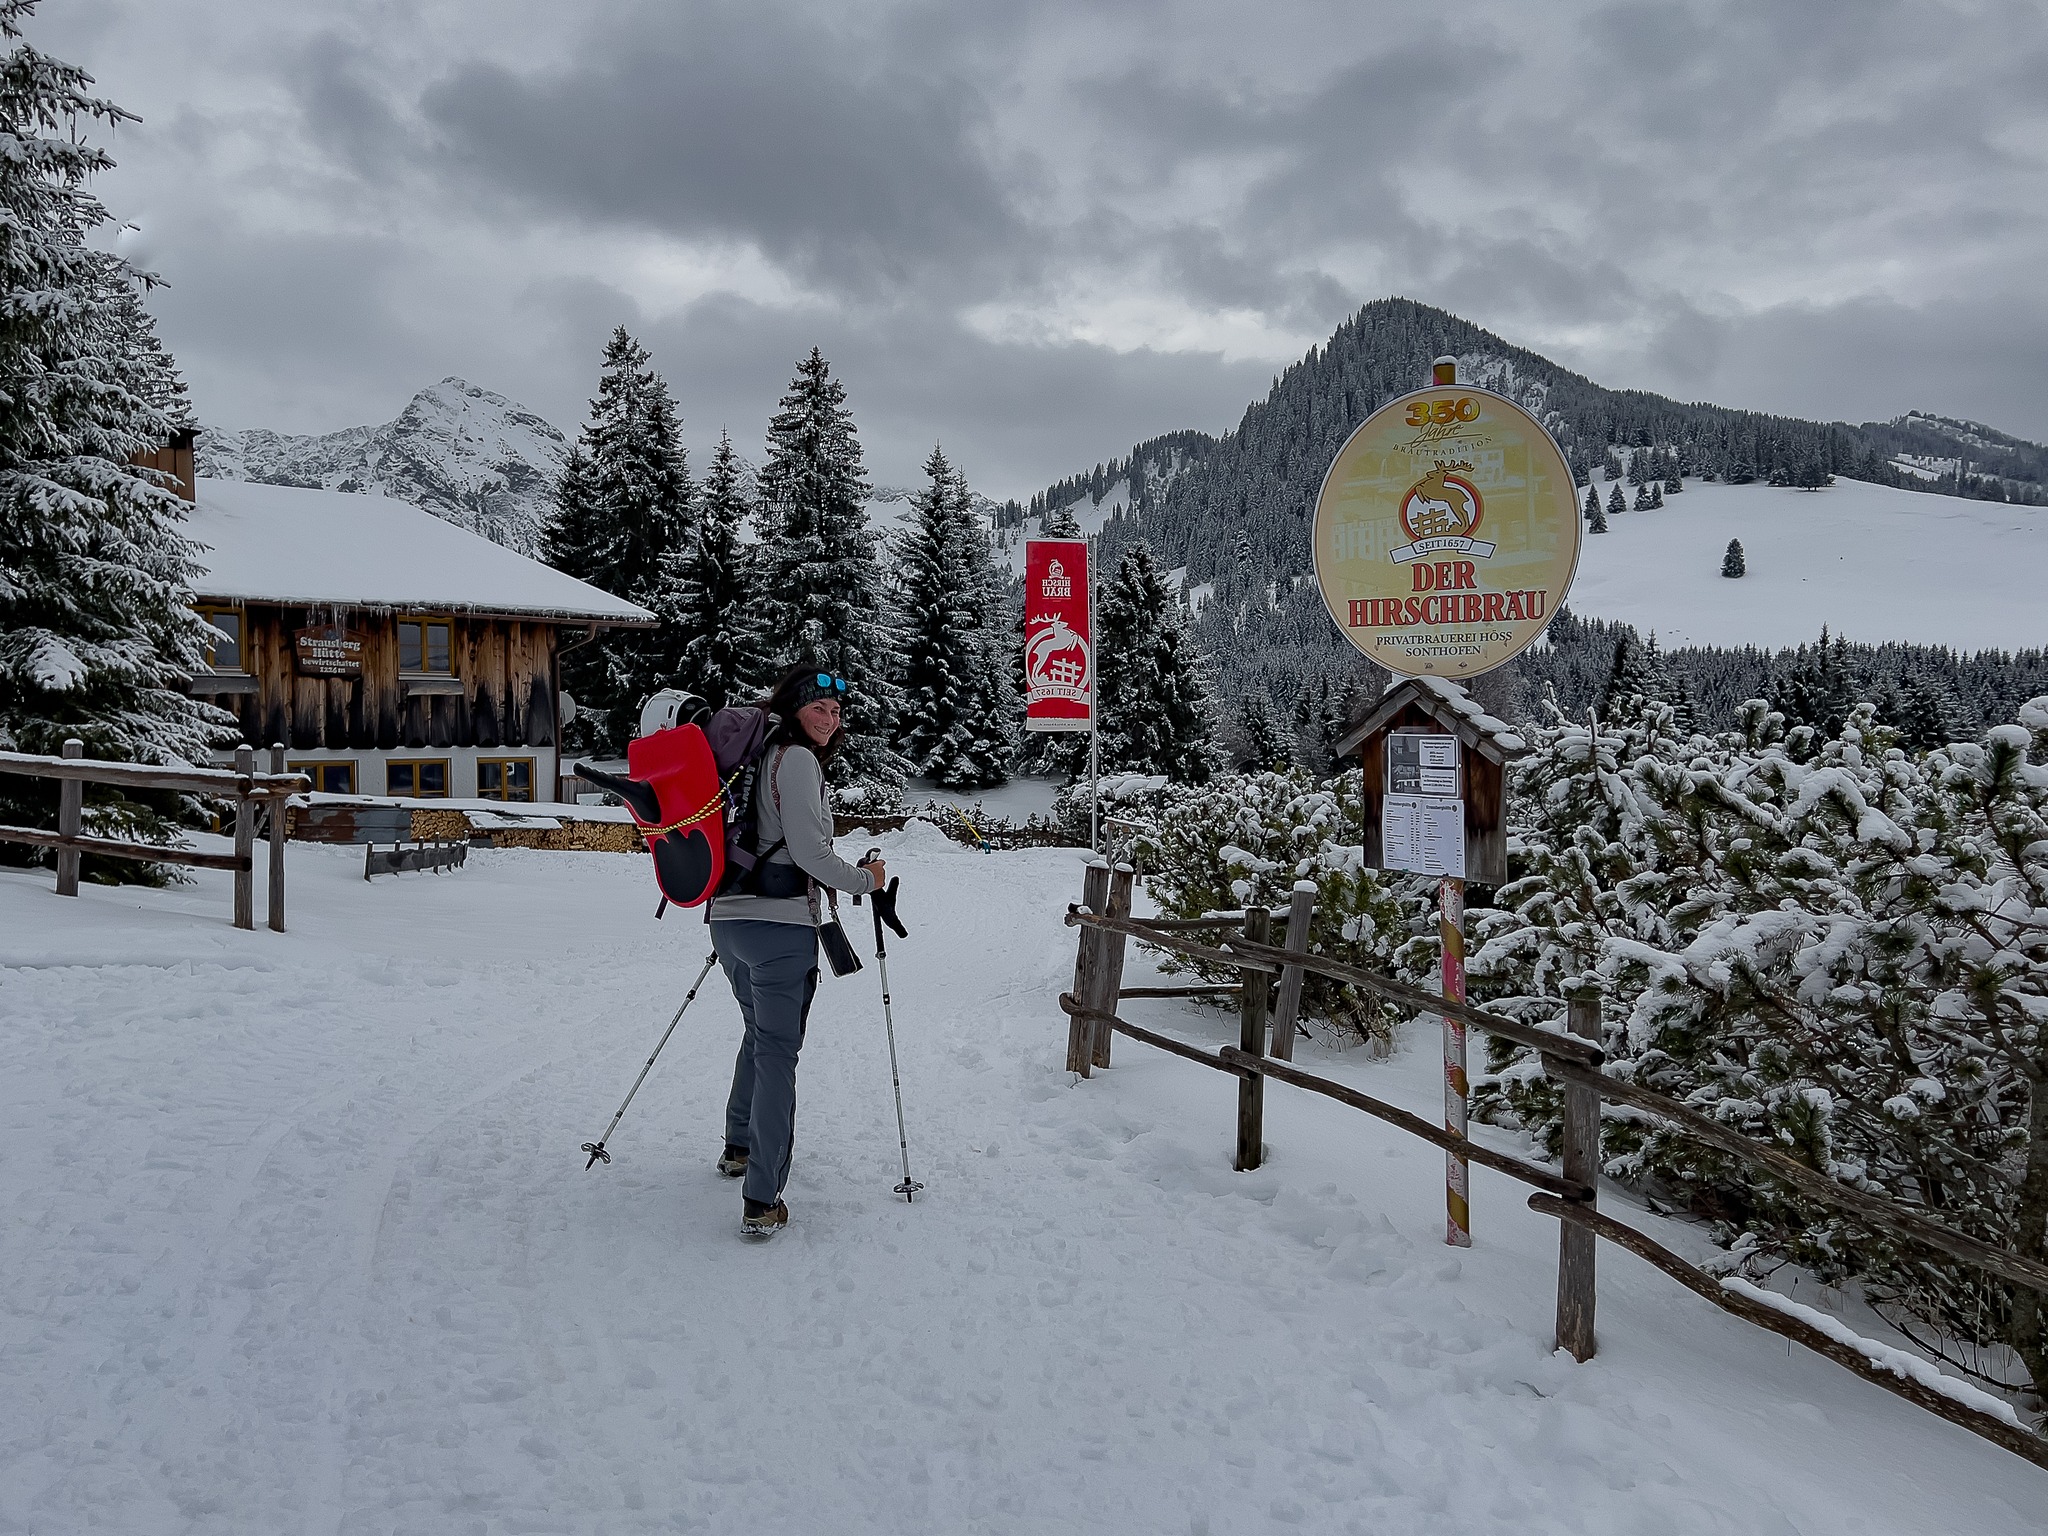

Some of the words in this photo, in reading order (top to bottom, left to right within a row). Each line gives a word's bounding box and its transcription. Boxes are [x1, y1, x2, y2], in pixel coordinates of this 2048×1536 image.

[1405, 397, 1481, 428] 350
[1393, 435, 1493, 457] BRAUTRADITION
[1418, 538, 1442, 551] SEIT
[1443, 537, 1466, 549] 1657
[1411, 560, 1478, 593] DER
[1348, 590, 1548, 628] HIRSCHBRÄU
[300, 637, 361, 651] Strausberg
[1376, 634, 1477, 647] PRIVATBRAUEREI
[1480, 629, 1513, 643] HÖSS
[312, 648, 346, 659] Hütte
[1405, 645, 1482, 657] SONTHOFEN
[302, 658, 360, 667] bewirtschaftet
